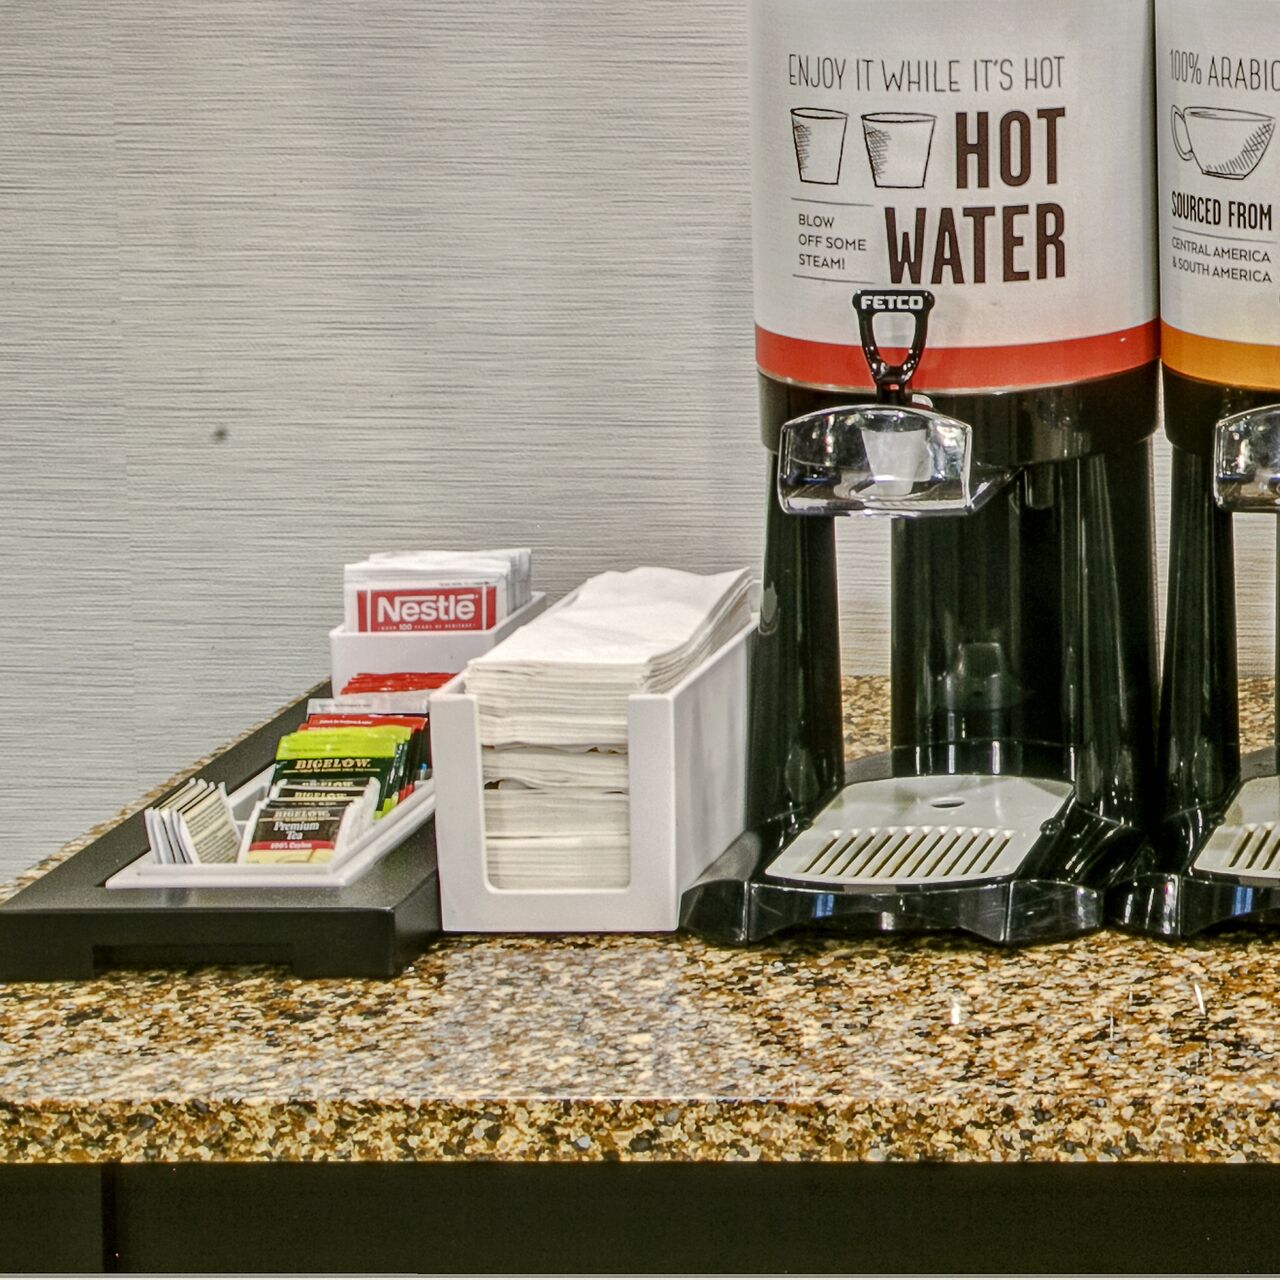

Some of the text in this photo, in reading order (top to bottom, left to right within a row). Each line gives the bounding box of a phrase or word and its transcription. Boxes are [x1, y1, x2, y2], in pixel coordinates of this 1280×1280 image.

[789, 54, 1065, 92] ENJOY IT WHILE IT'S HOT
[1169, 49, 1202, 85] 100%
[955, 106, 1066, 189] HOT
[798, 213, 835, 229] BLOW
[1171, 190, 1273, 231] SOURCED FROM
[798, 233, 867, 252] OFF SOME
[884, 202, 1066, 285] WATER
[1171, 236, 1272, 263] CENTRAL AMERICA
[798, 254, 845, 270] STEAM!
[1171, 258, 1273, 283] & SOUTH AMERICA
[860, 295, 924, 310] FETCO
[273, 821, 320, 832] Premium
[286, 831, 303, 840] Tea
